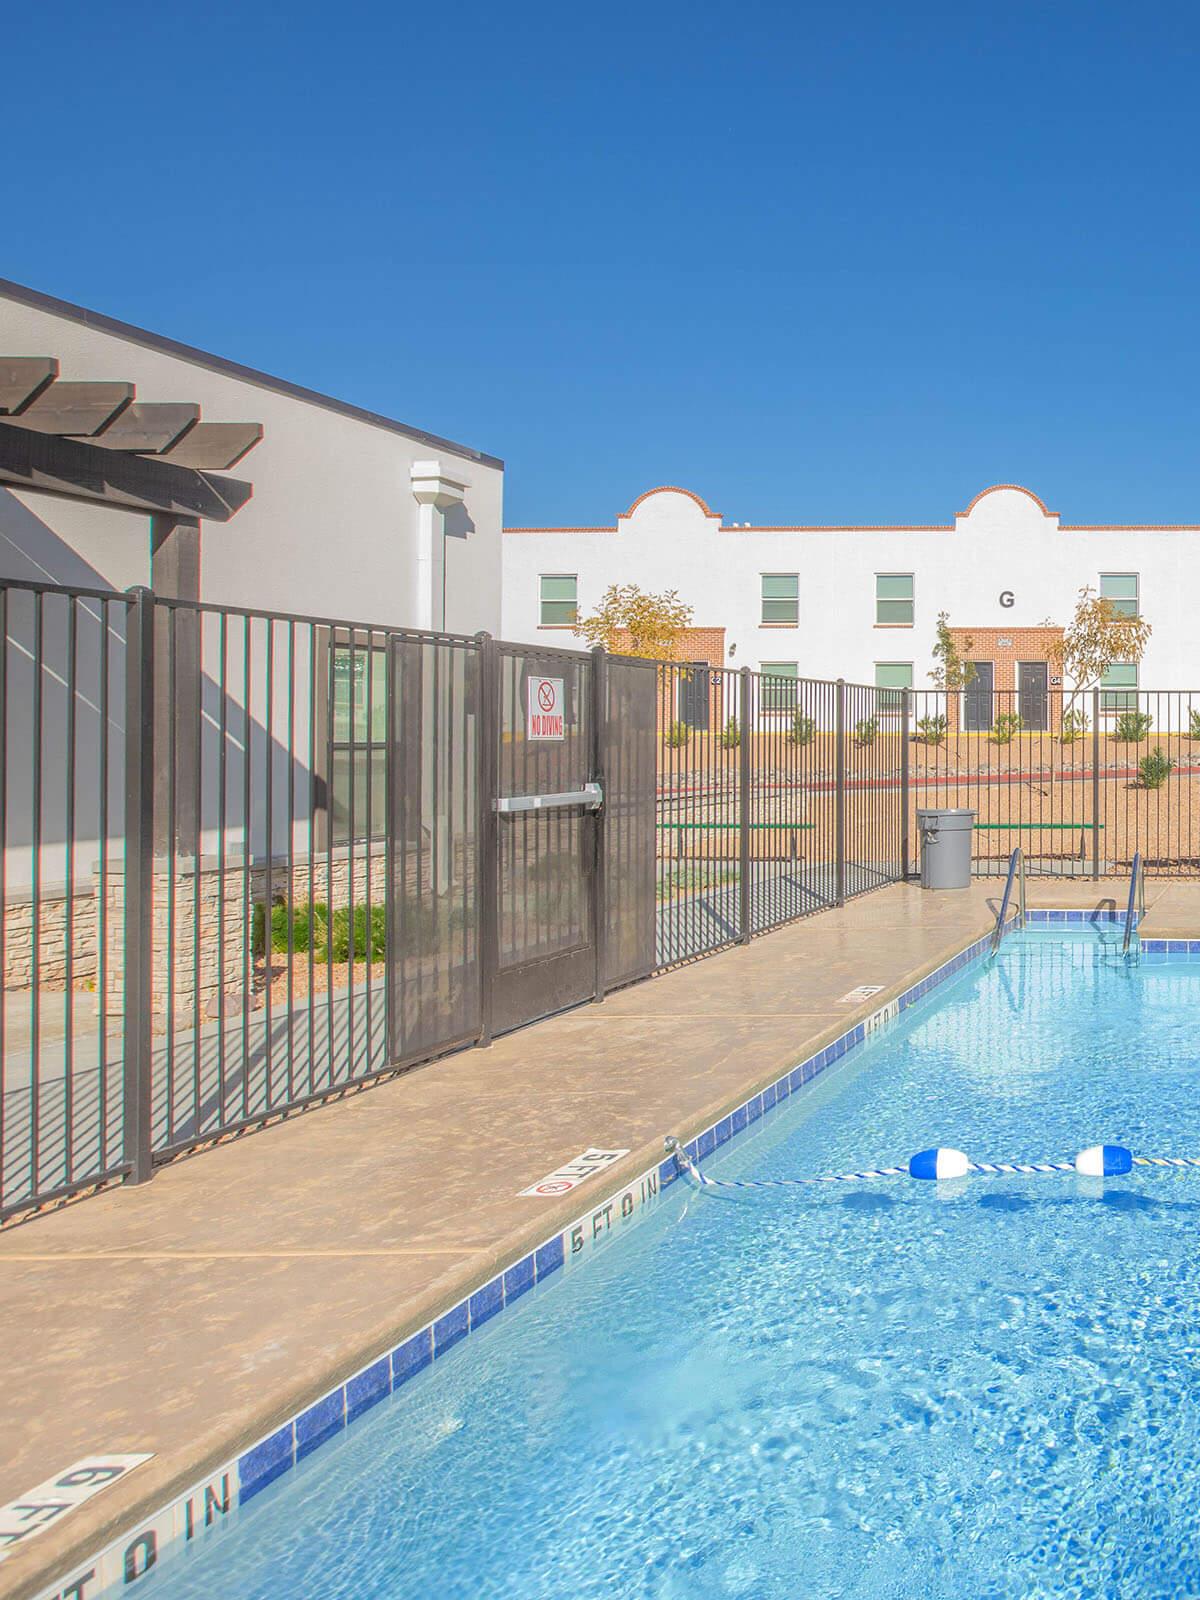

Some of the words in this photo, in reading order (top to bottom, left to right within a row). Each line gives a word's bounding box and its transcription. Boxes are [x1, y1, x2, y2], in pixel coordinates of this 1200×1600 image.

[999, 591, 1014, 608] G
[532, 714, 541, 736] NO
[542, 715, 562, 736] DIVING
[583, 1153, 618, 1161] 5
[554, 1165, 600, 1178] FT
[571, 1225, 584, 1253] 5
[593, 1204, 613, 1239] FT
[641, 1173, 657, 1203] IN
[55, 1466, 126, 1487] 6
[186, 1472, 230, 1541] IN
